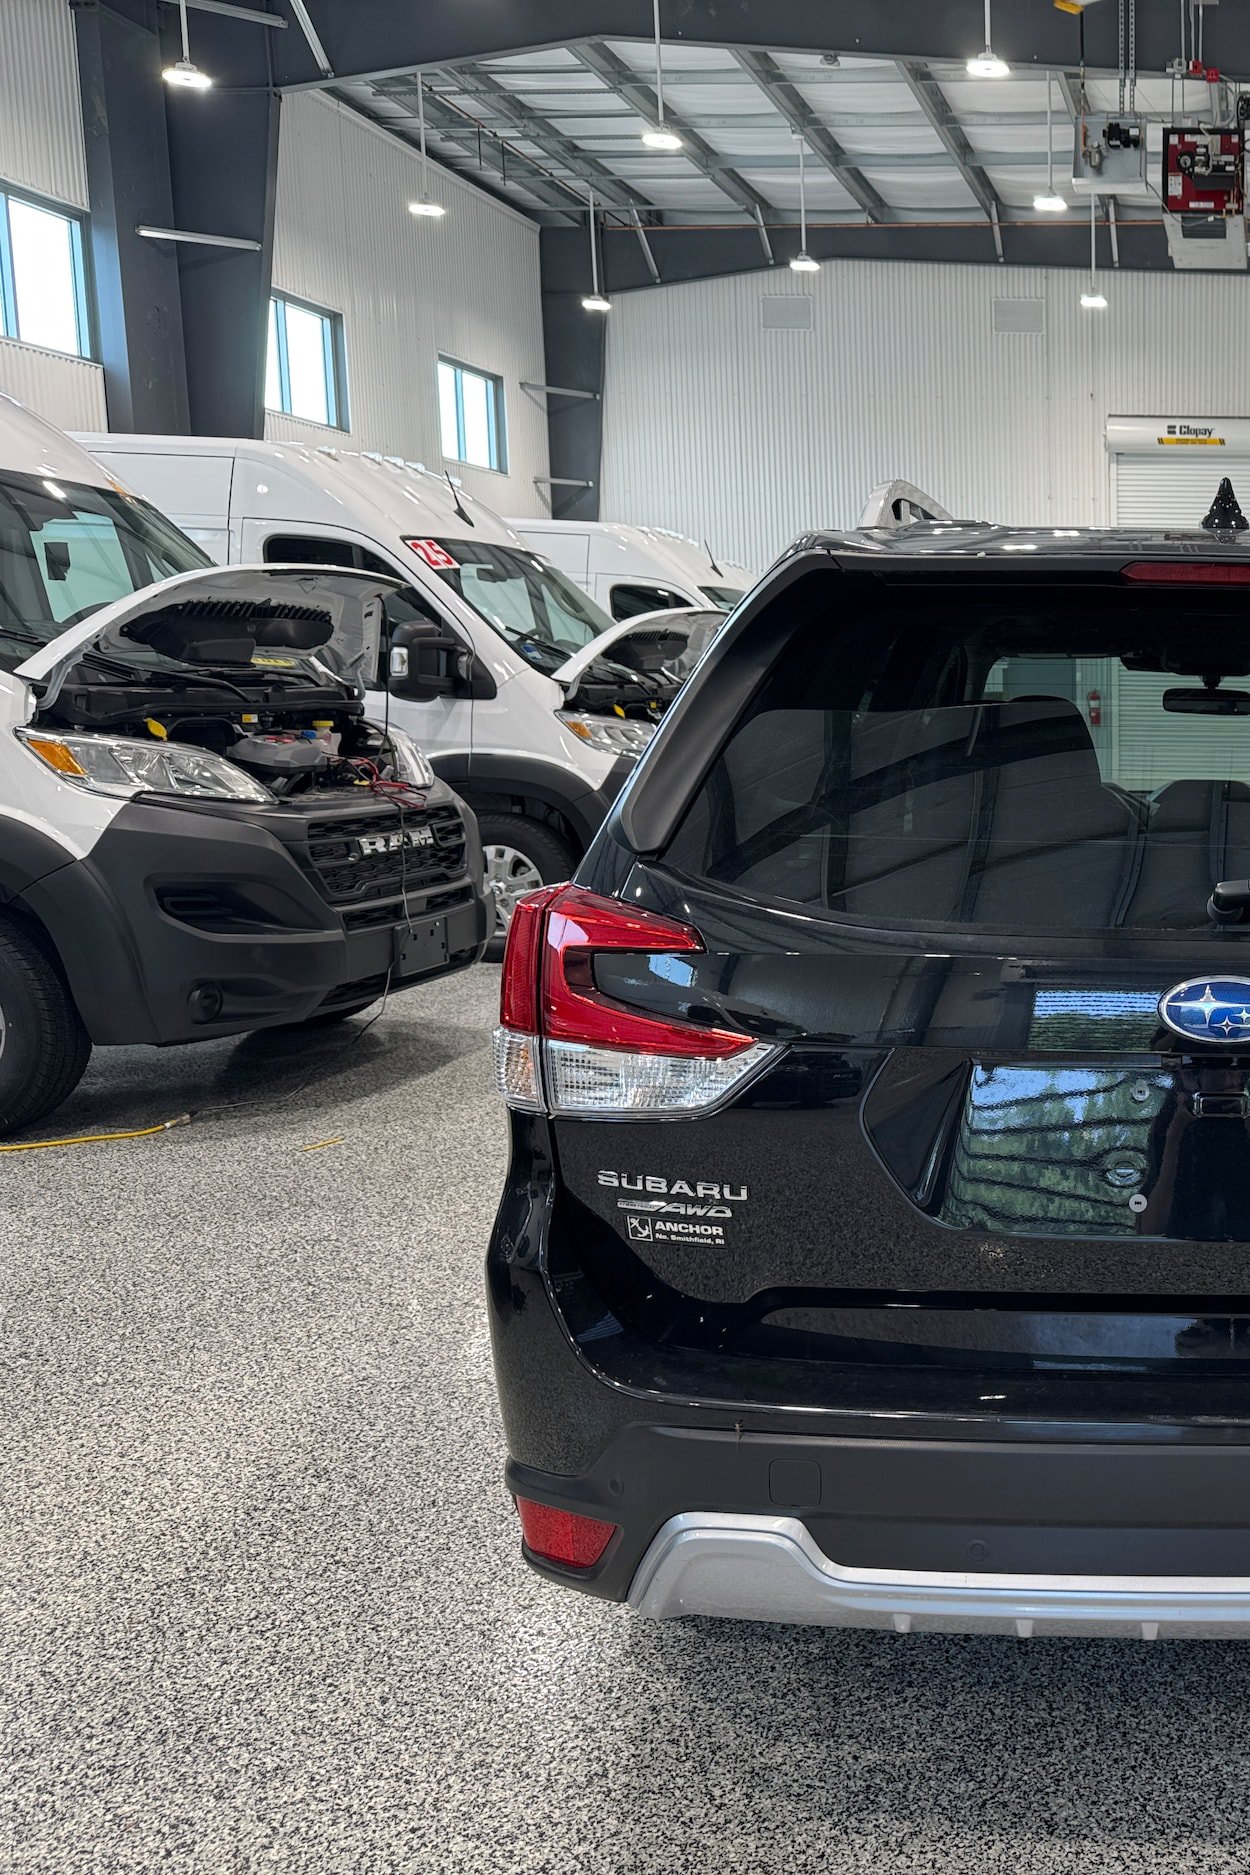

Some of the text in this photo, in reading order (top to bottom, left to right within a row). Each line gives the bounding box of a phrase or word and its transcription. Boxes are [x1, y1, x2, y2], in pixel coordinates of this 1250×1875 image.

[1179, 424, 1213, 438] Clopay
[410, 541, 453, 566] 25
[359, 827, 434, 855] RAM
[597, 1170, 748, 1200] SUBARU
[658, 1202, 733, 1218] AWD
[655, 1221, 724, 1236] ANCHOR
[670, 1234, 714, 1245] Smithfield,
